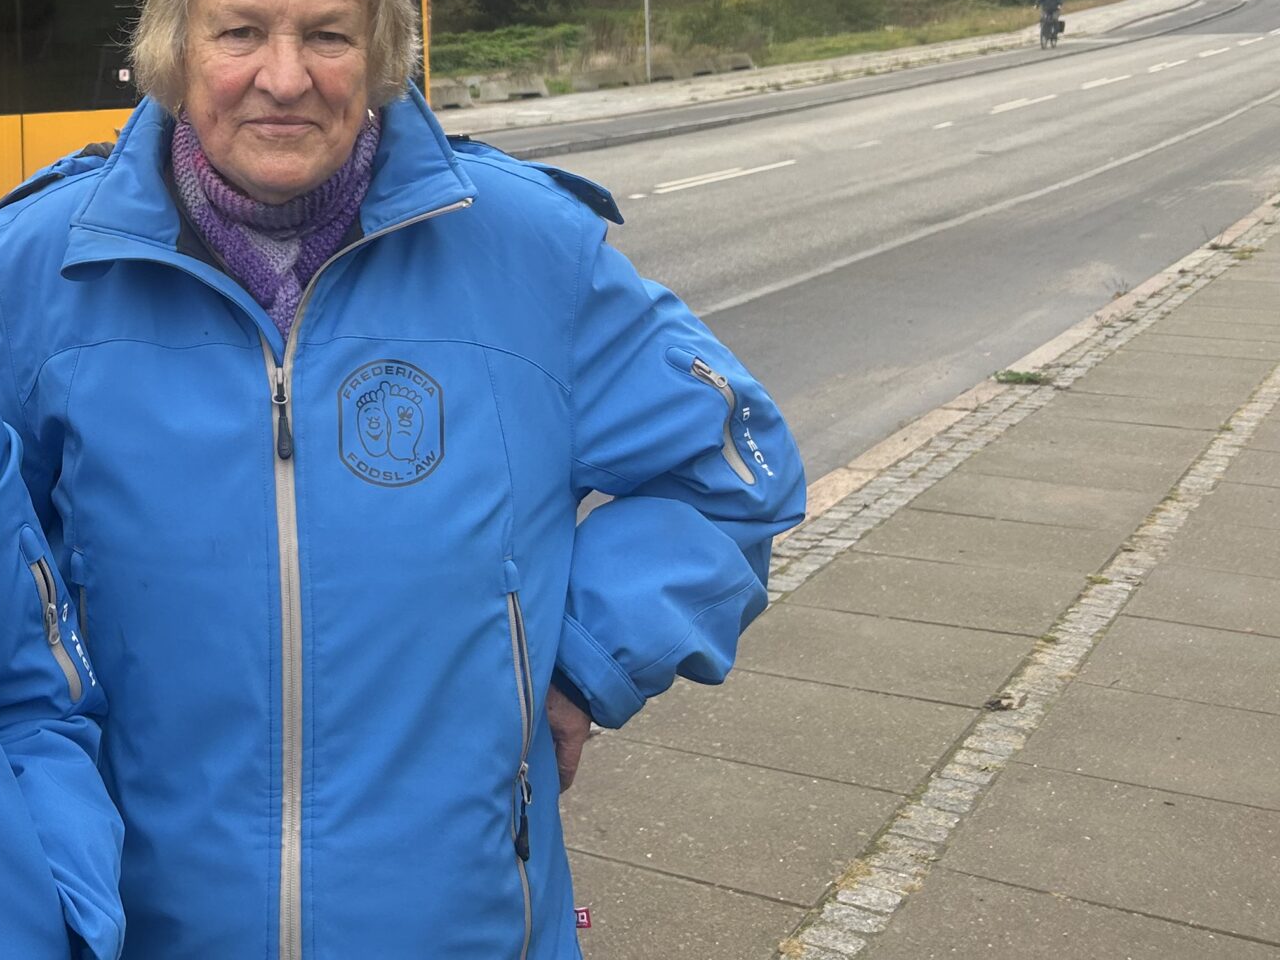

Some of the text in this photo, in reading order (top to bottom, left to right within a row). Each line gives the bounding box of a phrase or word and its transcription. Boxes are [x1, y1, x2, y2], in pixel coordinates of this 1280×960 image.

[343, 365, 436, 400] FREDERICIA
[742, 407, 750, 421] ID
[347, 450, 437, 481] FODSL-AW
